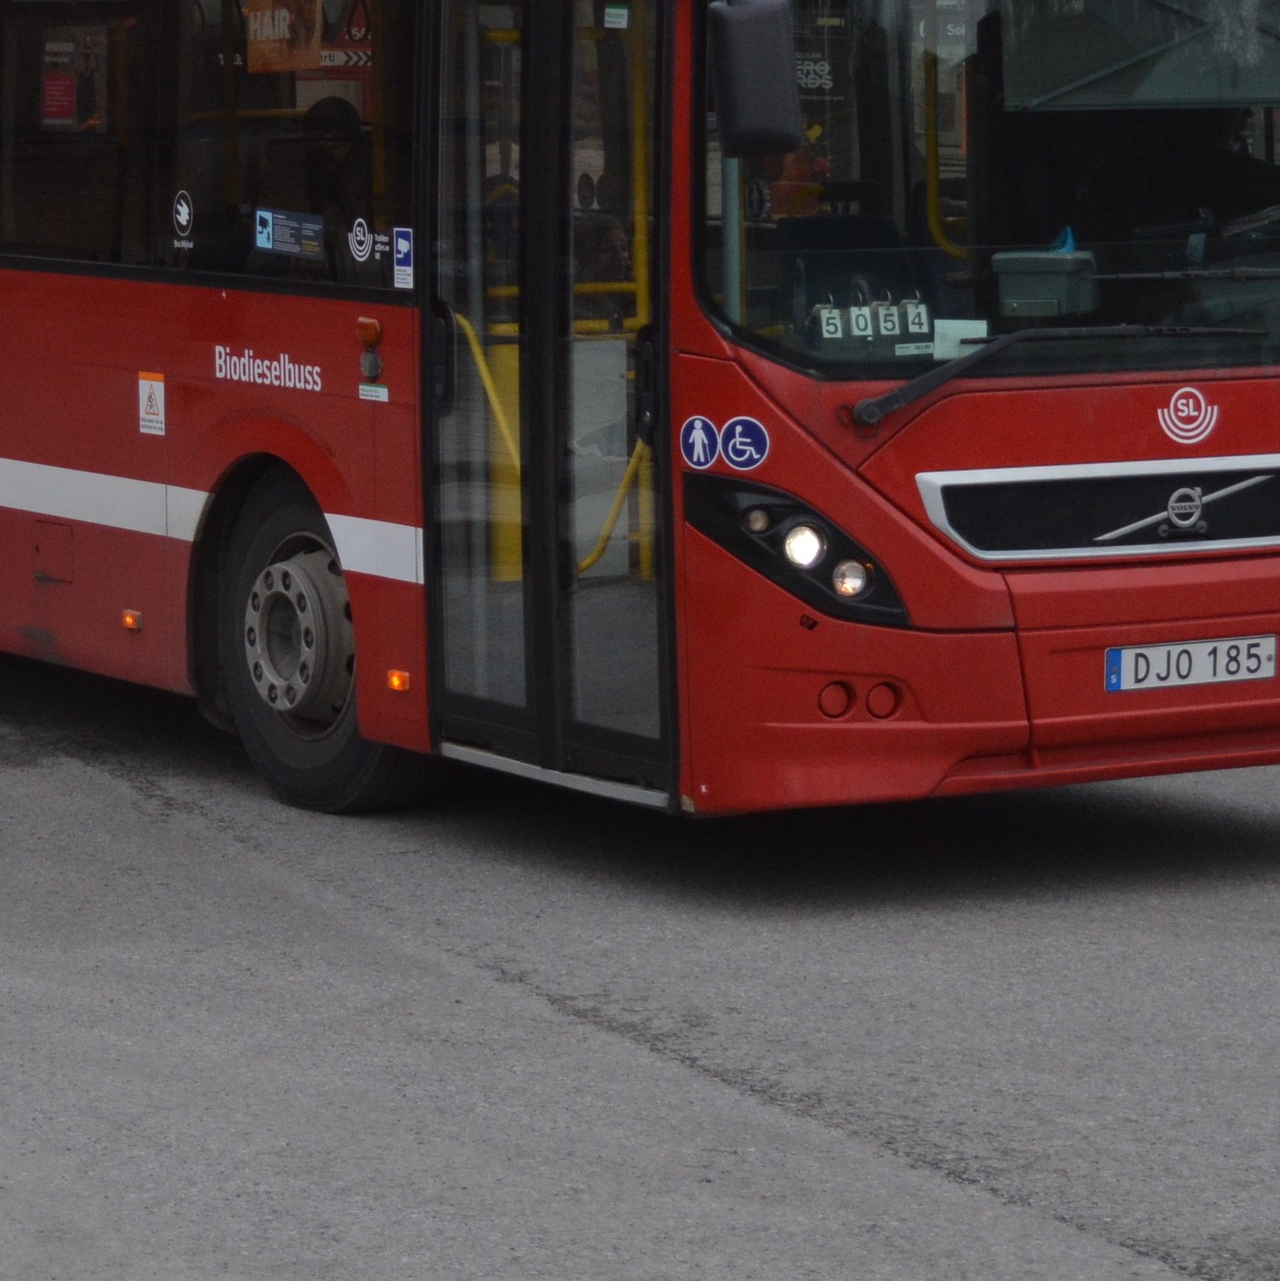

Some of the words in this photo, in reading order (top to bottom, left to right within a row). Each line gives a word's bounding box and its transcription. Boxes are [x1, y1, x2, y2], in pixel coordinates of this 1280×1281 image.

[249, 9, 291, 40] HAIR
[355, 226, 365, 241] SL
[215, 345, 322, 391] Biodieselbuss
[1176, 398, 1199, 417] SL
[1133, 648, 1193, 684] DJO
[1208, 642, 1262, 678] 185
